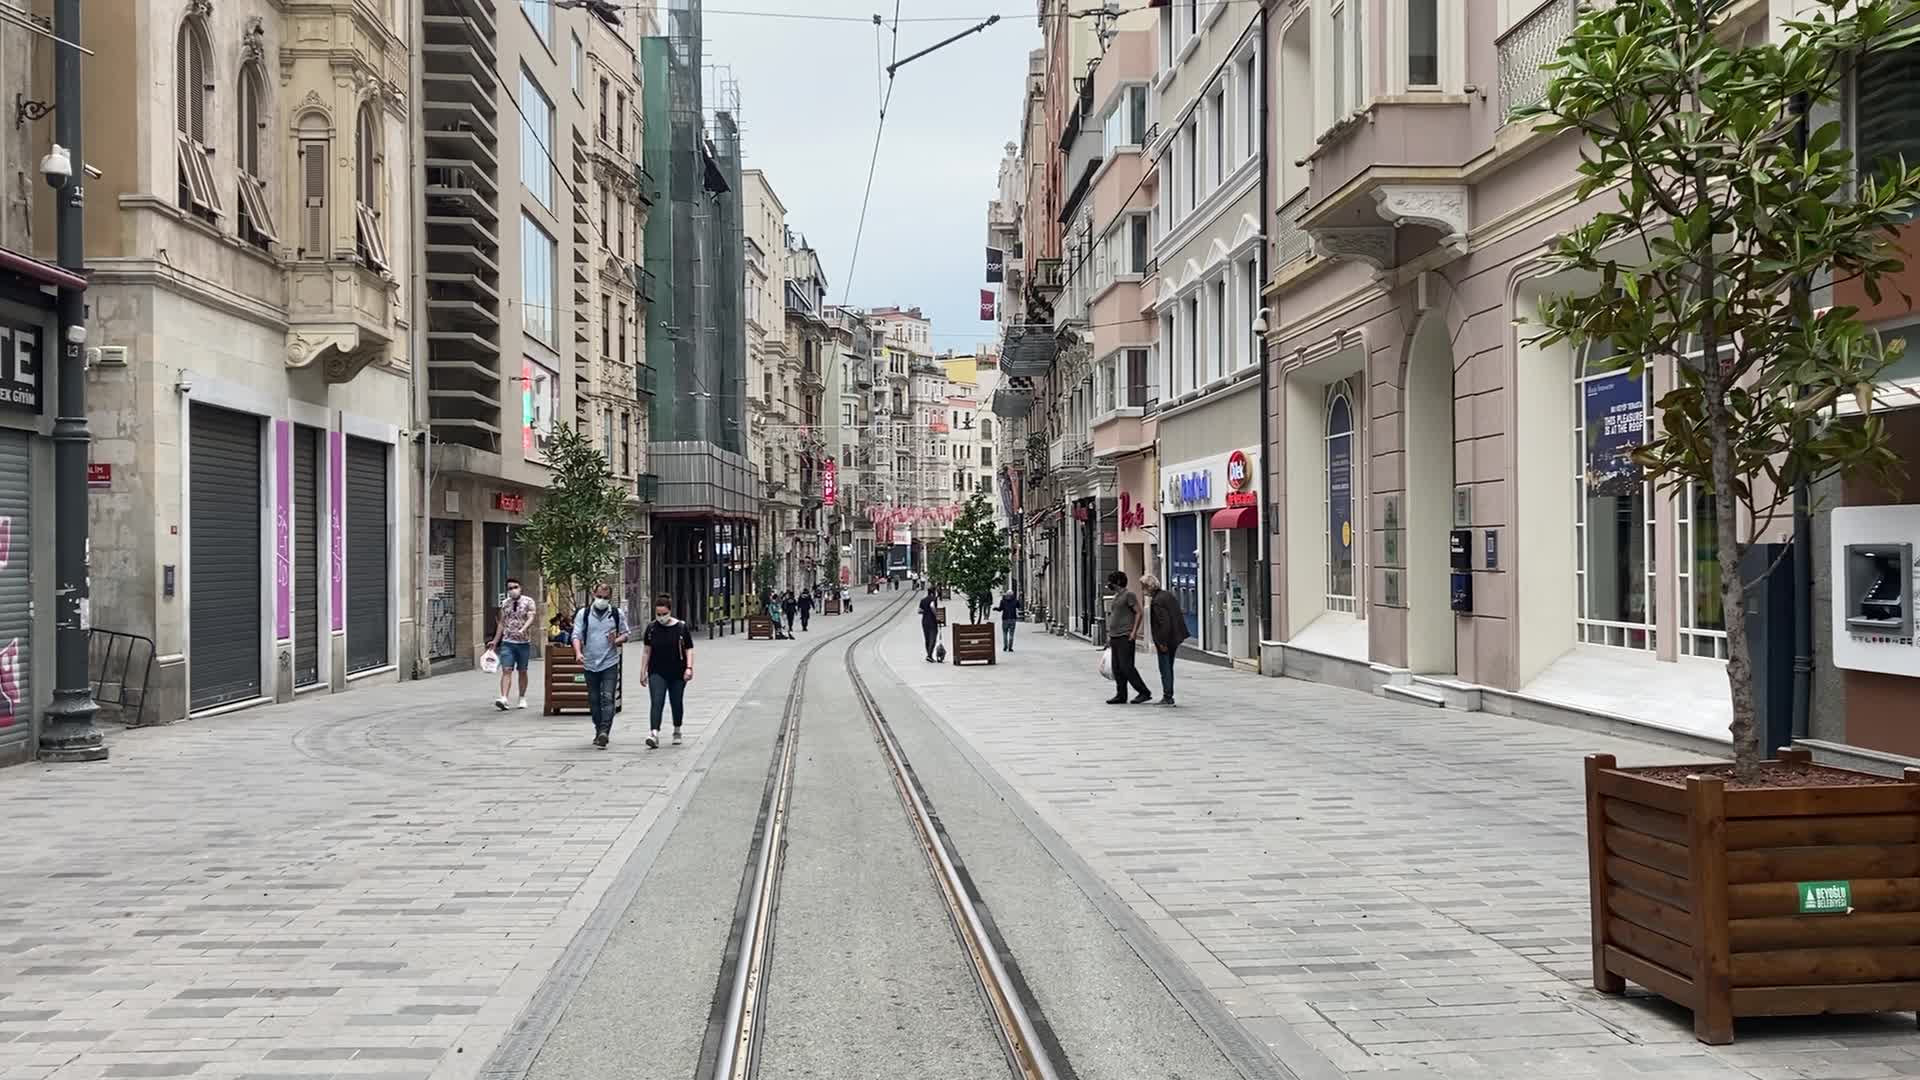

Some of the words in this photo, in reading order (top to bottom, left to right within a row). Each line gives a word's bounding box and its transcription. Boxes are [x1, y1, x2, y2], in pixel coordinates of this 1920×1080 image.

[1604, 416, 1616, 426] THIS
[1617, 411, 1643, 424] PLEASURE
[1604, 426, 1610, 436] IS
[1611, 424, 1617, 434] AT
[1618, 423, 1628, 433] THE
[1628, 420, 1643, 432] ROOF
[825, 472, 833, 496] CHP
